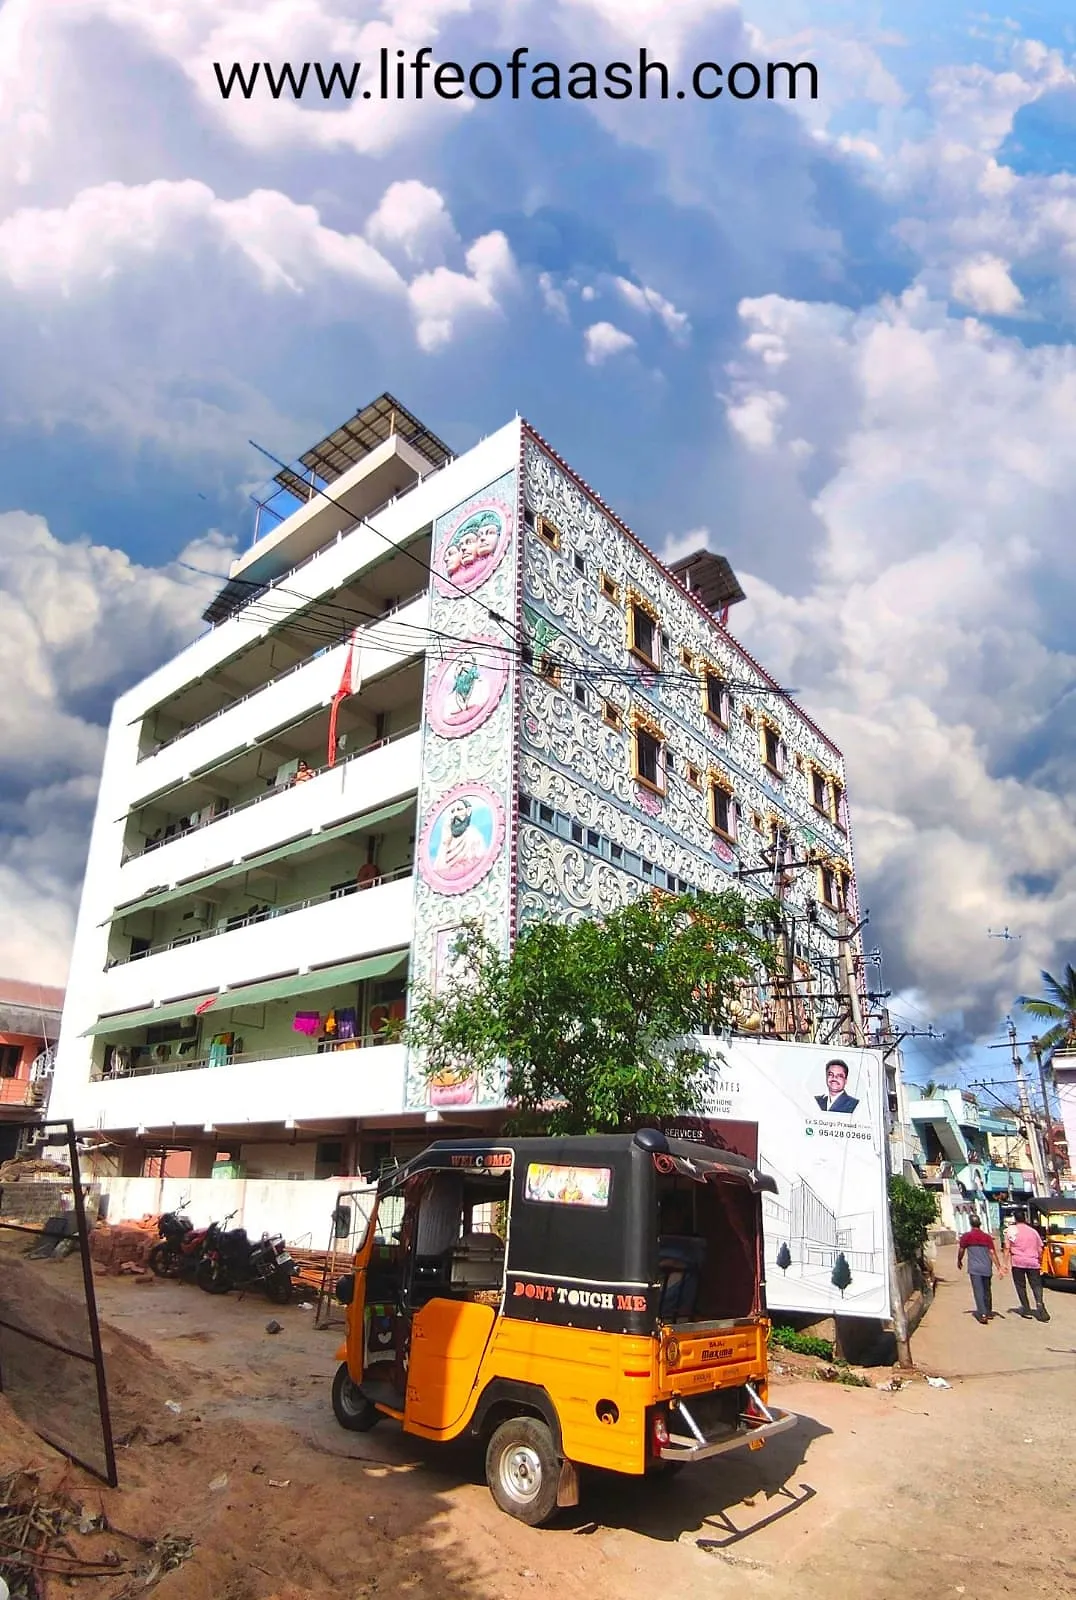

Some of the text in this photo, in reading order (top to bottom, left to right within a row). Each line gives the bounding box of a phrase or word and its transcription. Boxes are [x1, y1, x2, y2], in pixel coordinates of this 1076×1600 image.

[664, 1128, 703, 1138] SERVICES
[818, 1129, 844, 1138] 95428
[451, 1153, 512, 1167] WELCOME
[513, 1281, 647, 1312] DONT TOUCH ME
